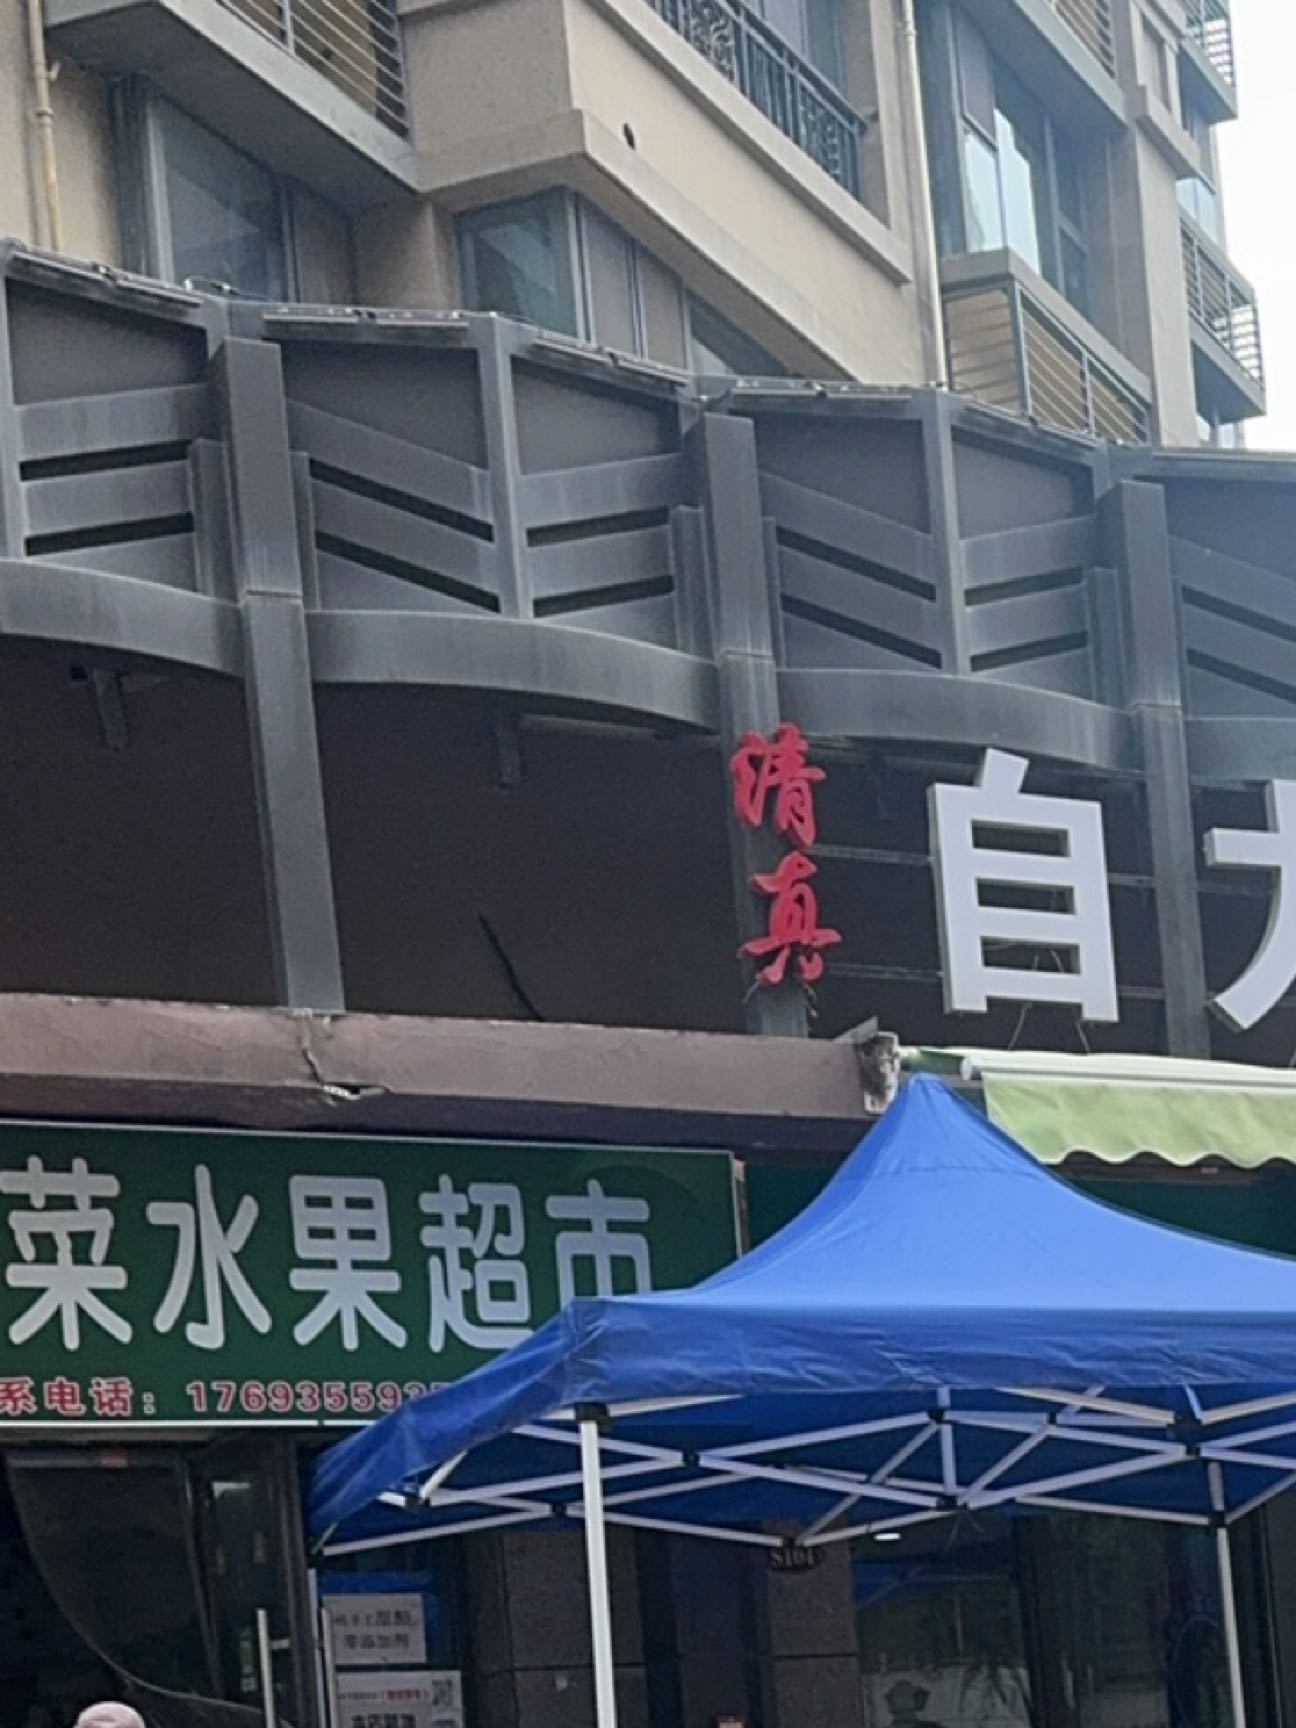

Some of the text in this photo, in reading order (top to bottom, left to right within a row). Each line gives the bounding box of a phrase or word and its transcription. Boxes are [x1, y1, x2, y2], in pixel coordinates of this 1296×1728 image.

[729, 720, 842, 985] 清真
[0, 1155, 651, 1353] 菜水果超市
